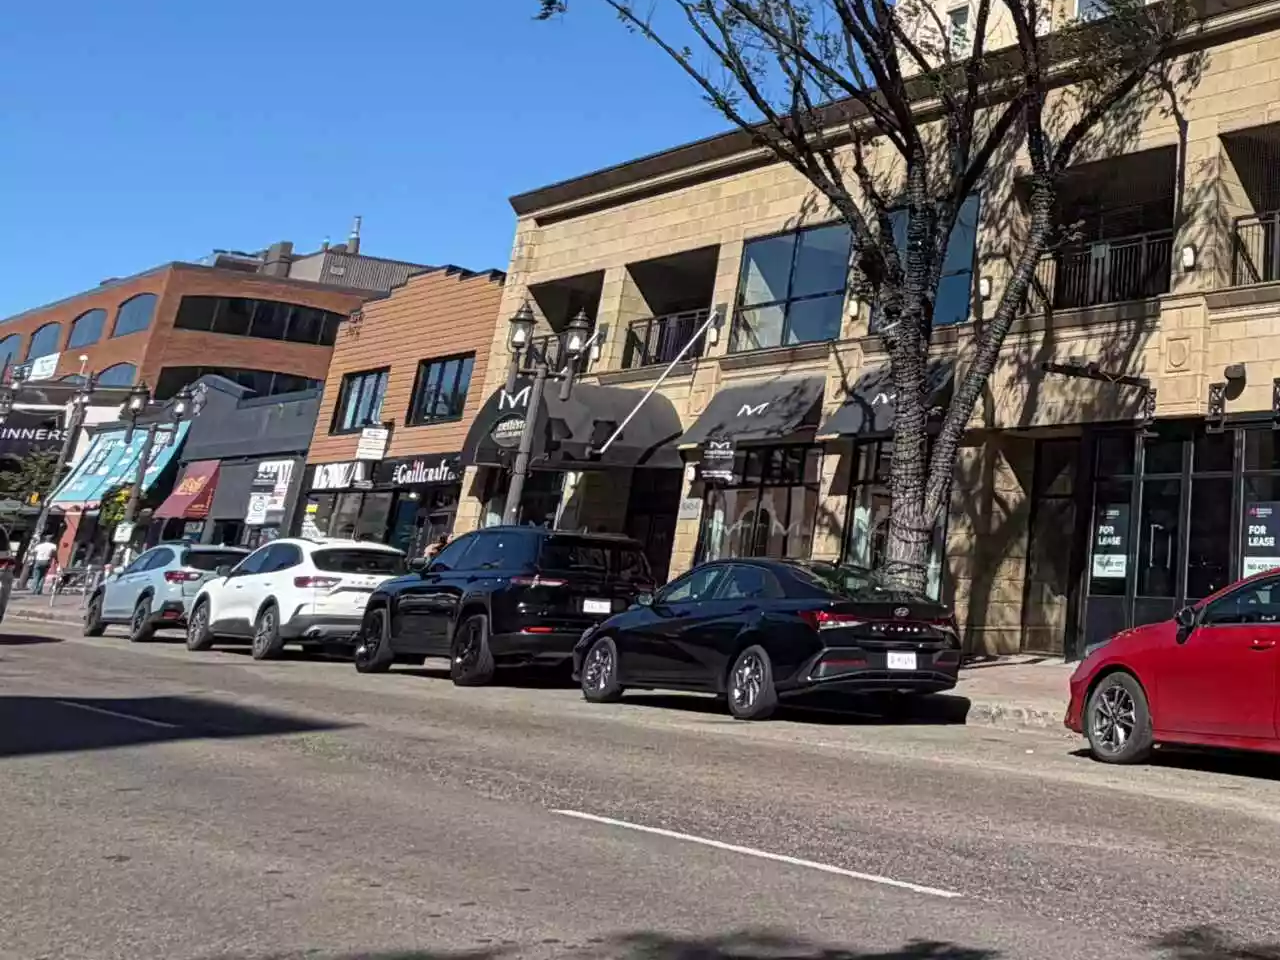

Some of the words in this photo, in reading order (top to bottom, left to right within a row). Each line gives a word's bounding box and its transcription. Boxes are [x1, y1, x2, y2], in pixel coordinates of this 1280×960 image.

[1099, 525, 1114, 534] FOR
[1248, 525, 1267, 535] FOR
[1098, 536, 1121, 546] LEASE
[1248, 536, 1275, 547] LEASE
